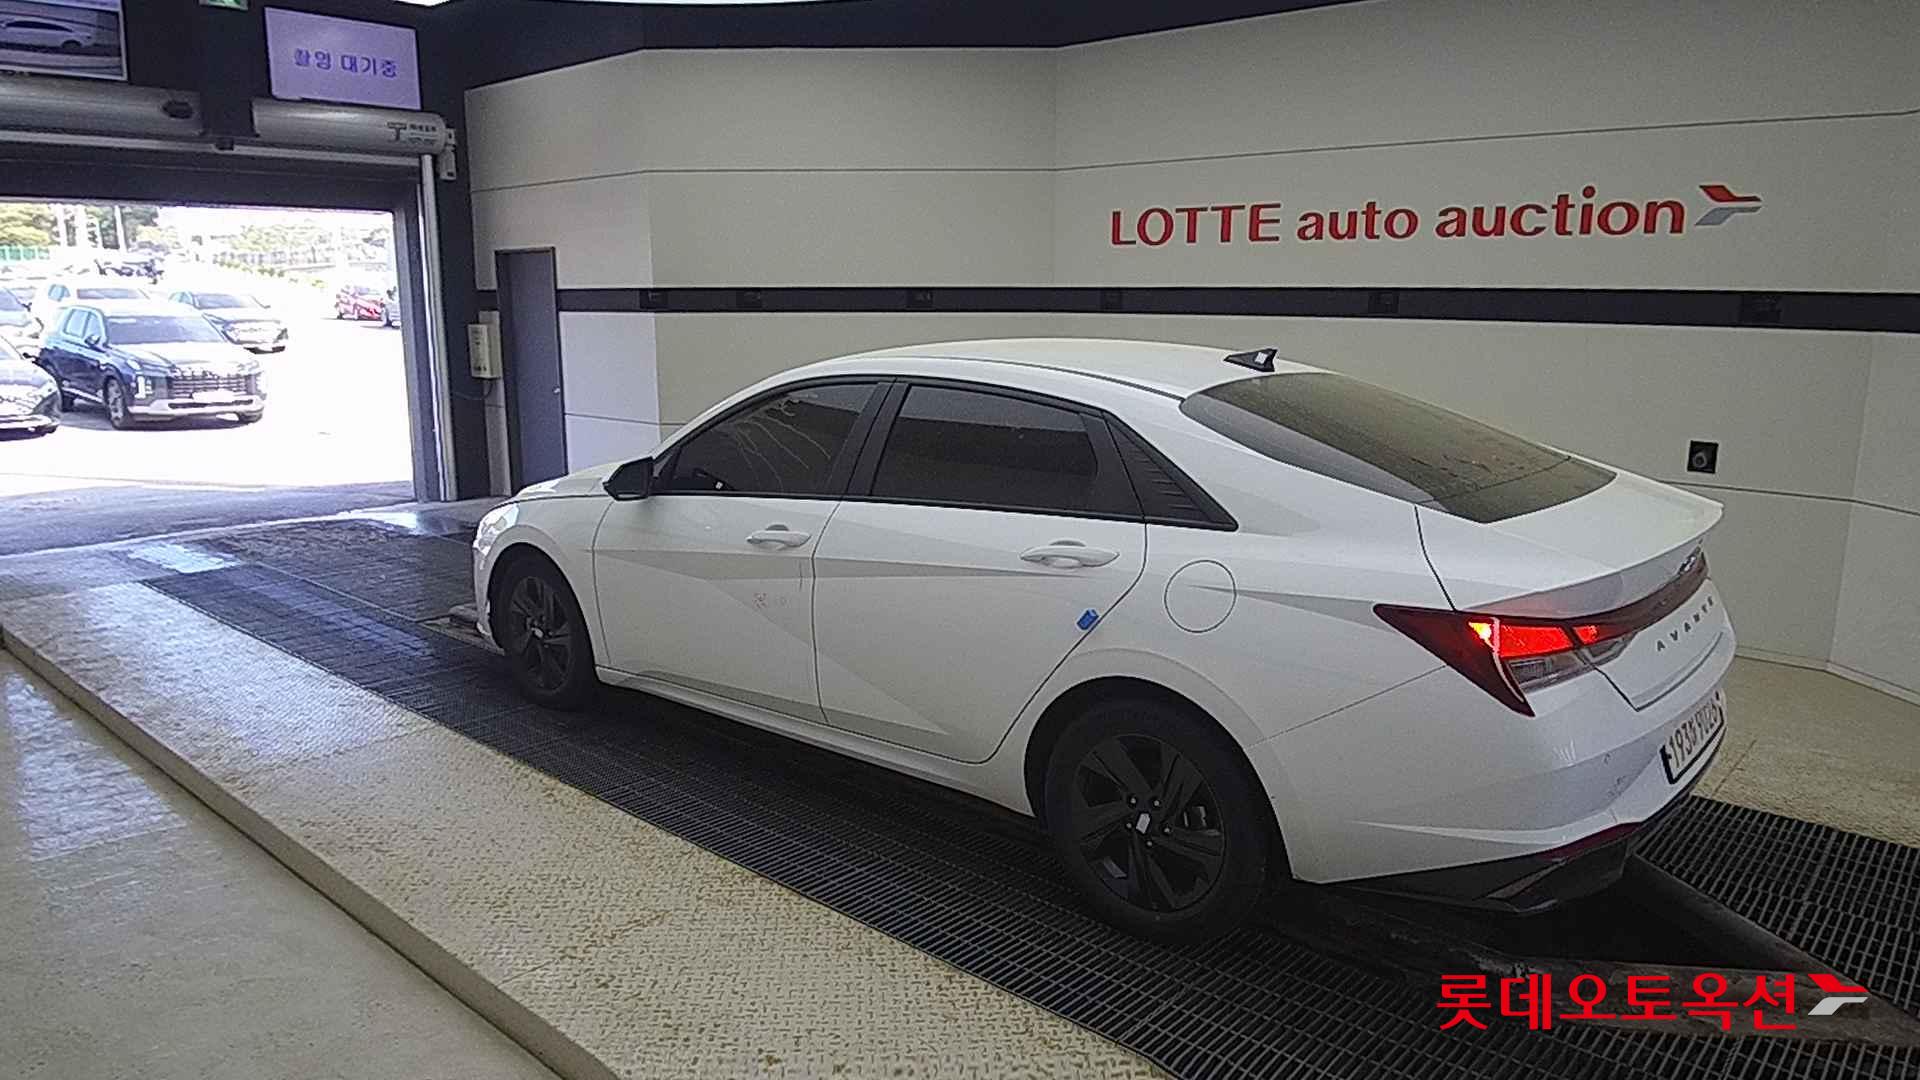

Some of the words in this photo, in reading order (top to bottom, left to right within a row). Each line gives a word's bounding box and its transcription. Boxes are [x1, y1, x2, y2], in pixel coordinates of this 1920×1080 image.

[341, 54, 397, 78] 대기중
[1110, 203, 1281, 246] LOTTE
[1296, 201, 1419, 241] auto
[1434, 185, 1686, 238] auction
[1656, 595, 1714, 652] AVANTE
